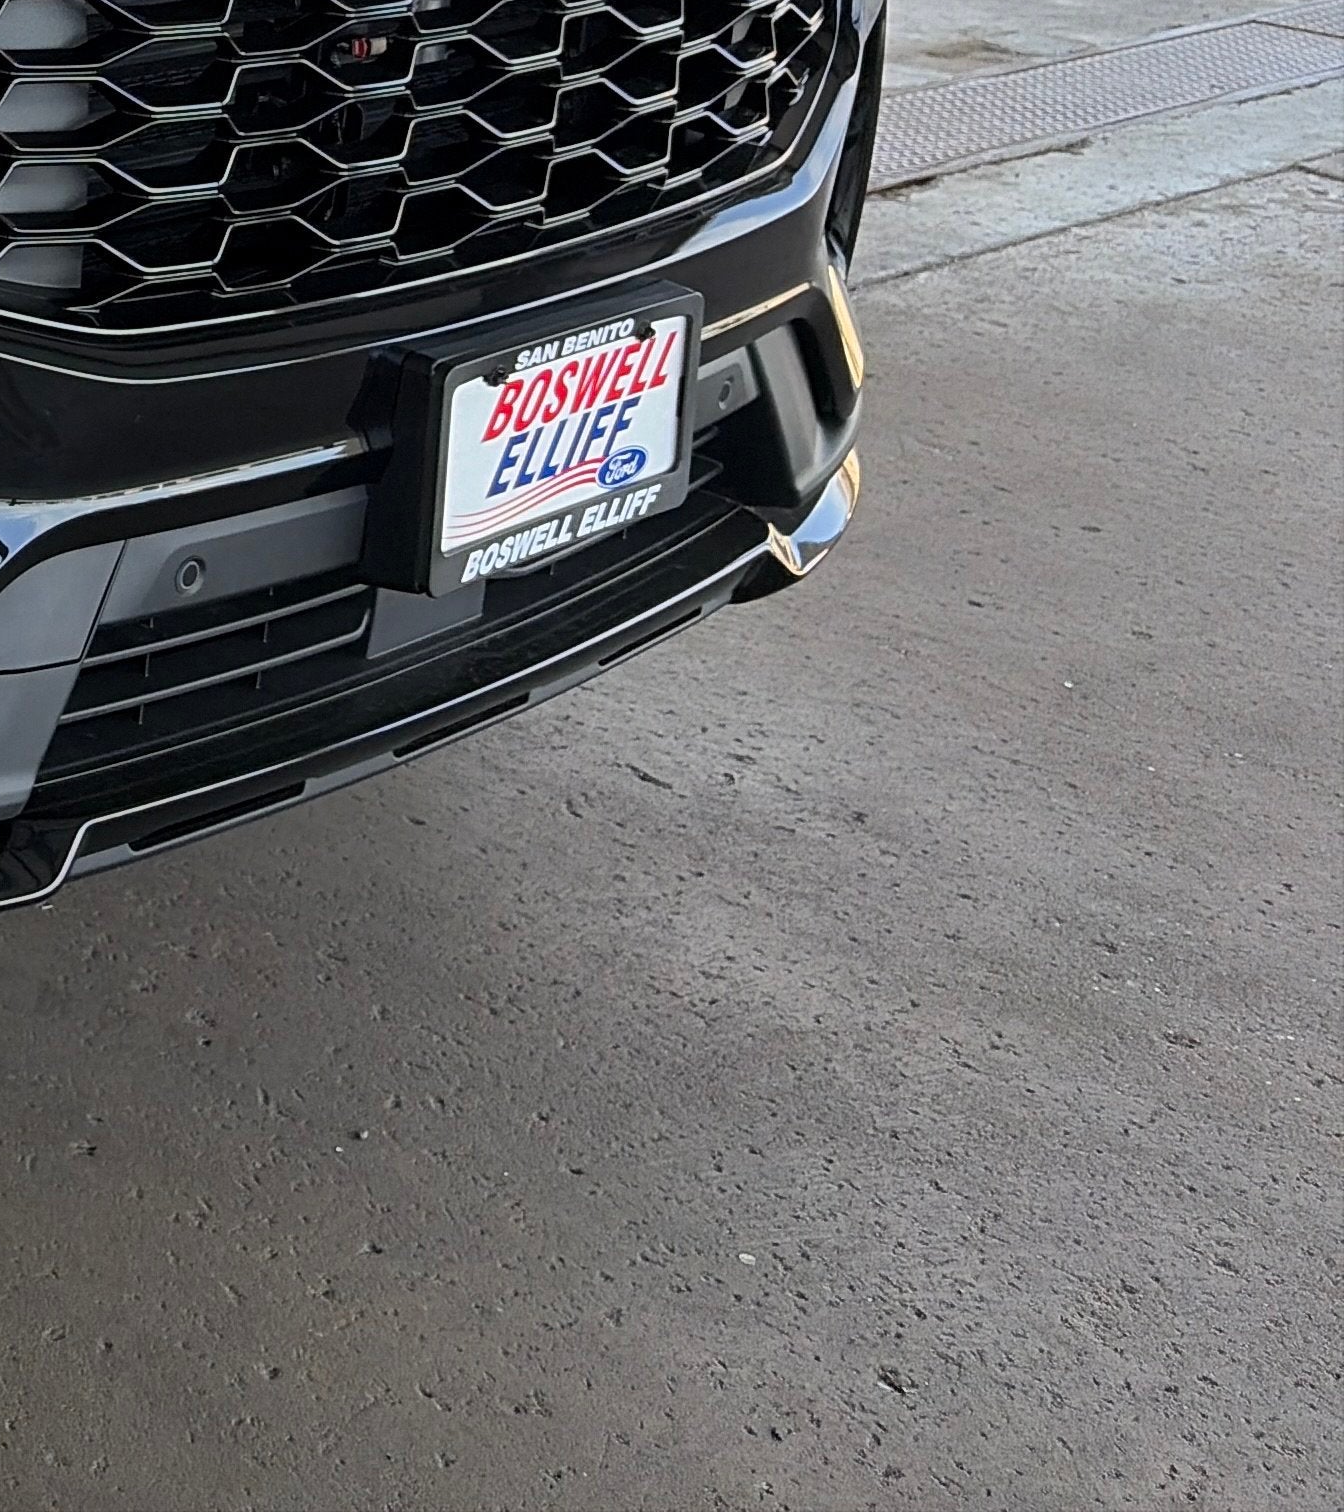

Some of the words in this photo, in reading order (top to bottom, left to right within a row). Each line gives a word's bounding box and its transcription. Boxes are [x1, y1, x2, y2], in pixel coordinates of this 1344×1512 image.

[480, 330, 678, 444] BOSWELL
[514, 340, 558, 371] SAN
[561, 317, 635, 357] BENITO
[485, 394, 642, 499] ELLIFF
[605, 455, 640, 485] Ford
[461, 514, 573, 584] BOSWELL
[577, 483, 662, 537] ELLIFF
